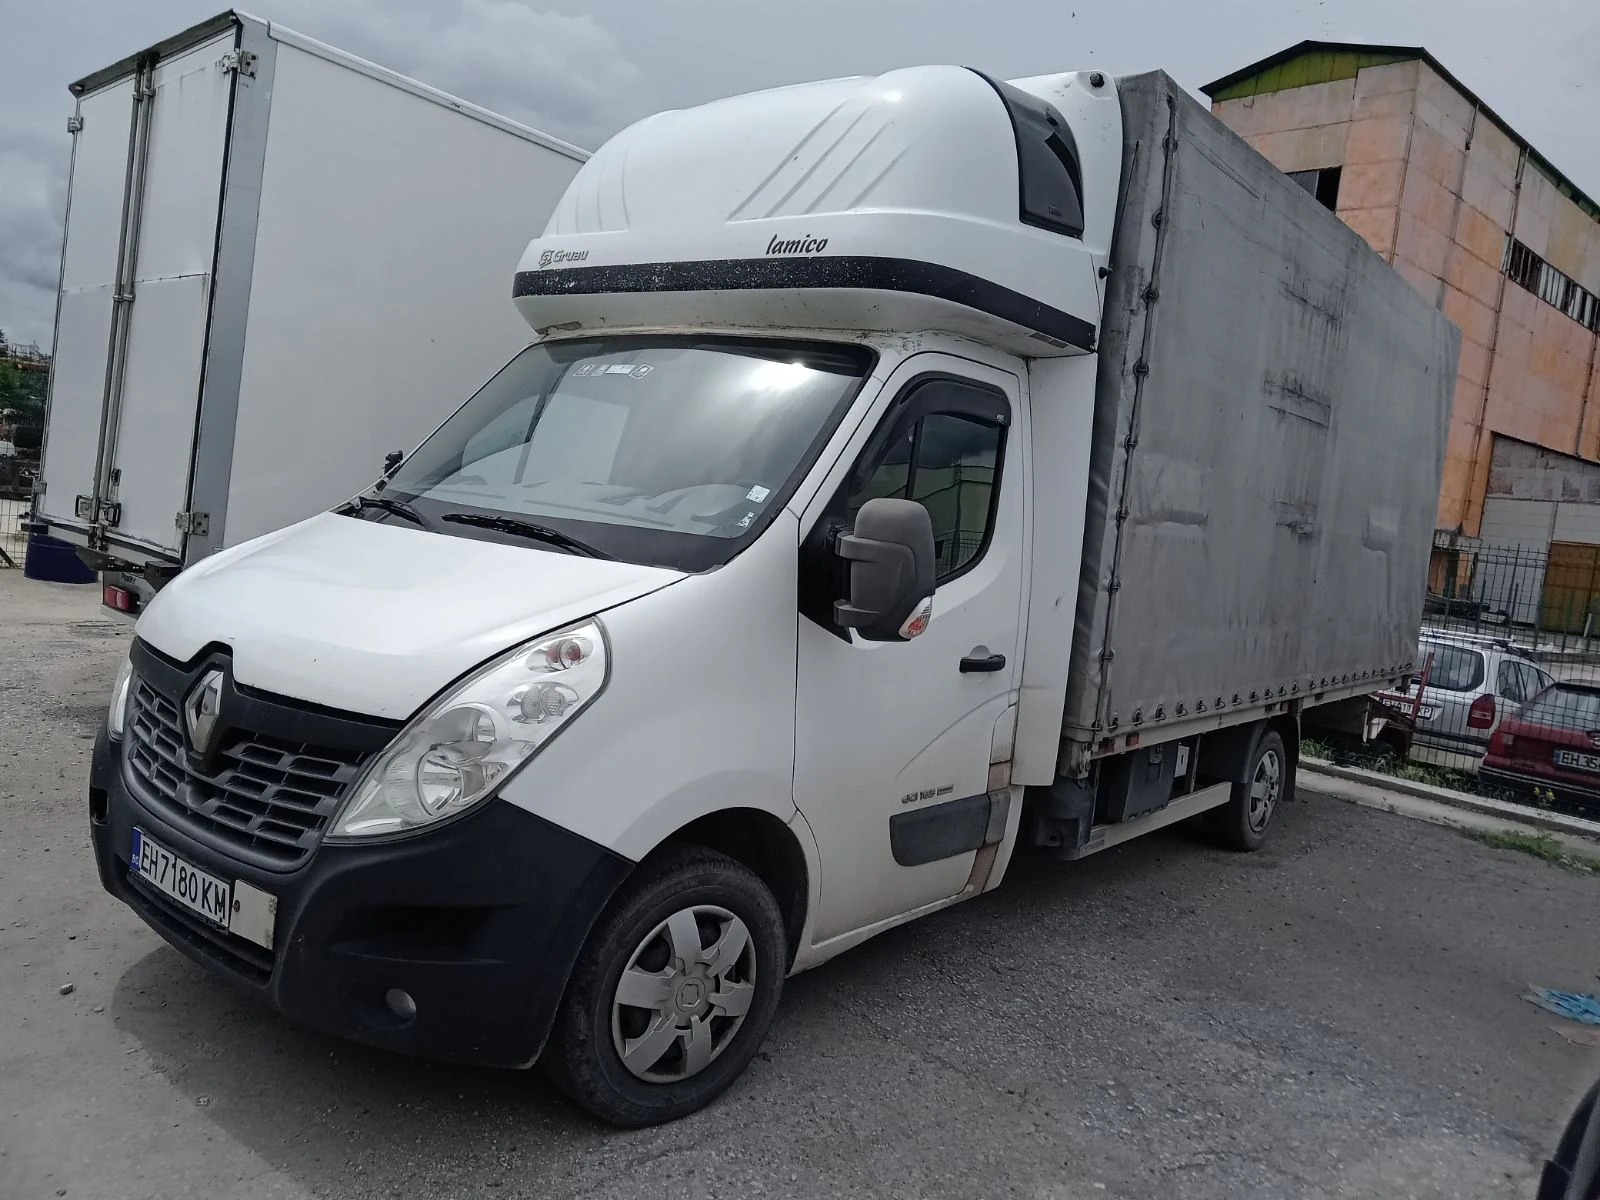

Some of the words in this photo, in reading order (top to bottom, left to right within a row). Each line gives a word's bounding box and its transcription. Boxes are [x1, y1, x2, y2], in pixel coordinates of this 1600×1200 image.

[554, 250, 590, 263] Gruau
[131, 854, 140, 866] BG
[141, 839, 226, 920] EH7180KM
